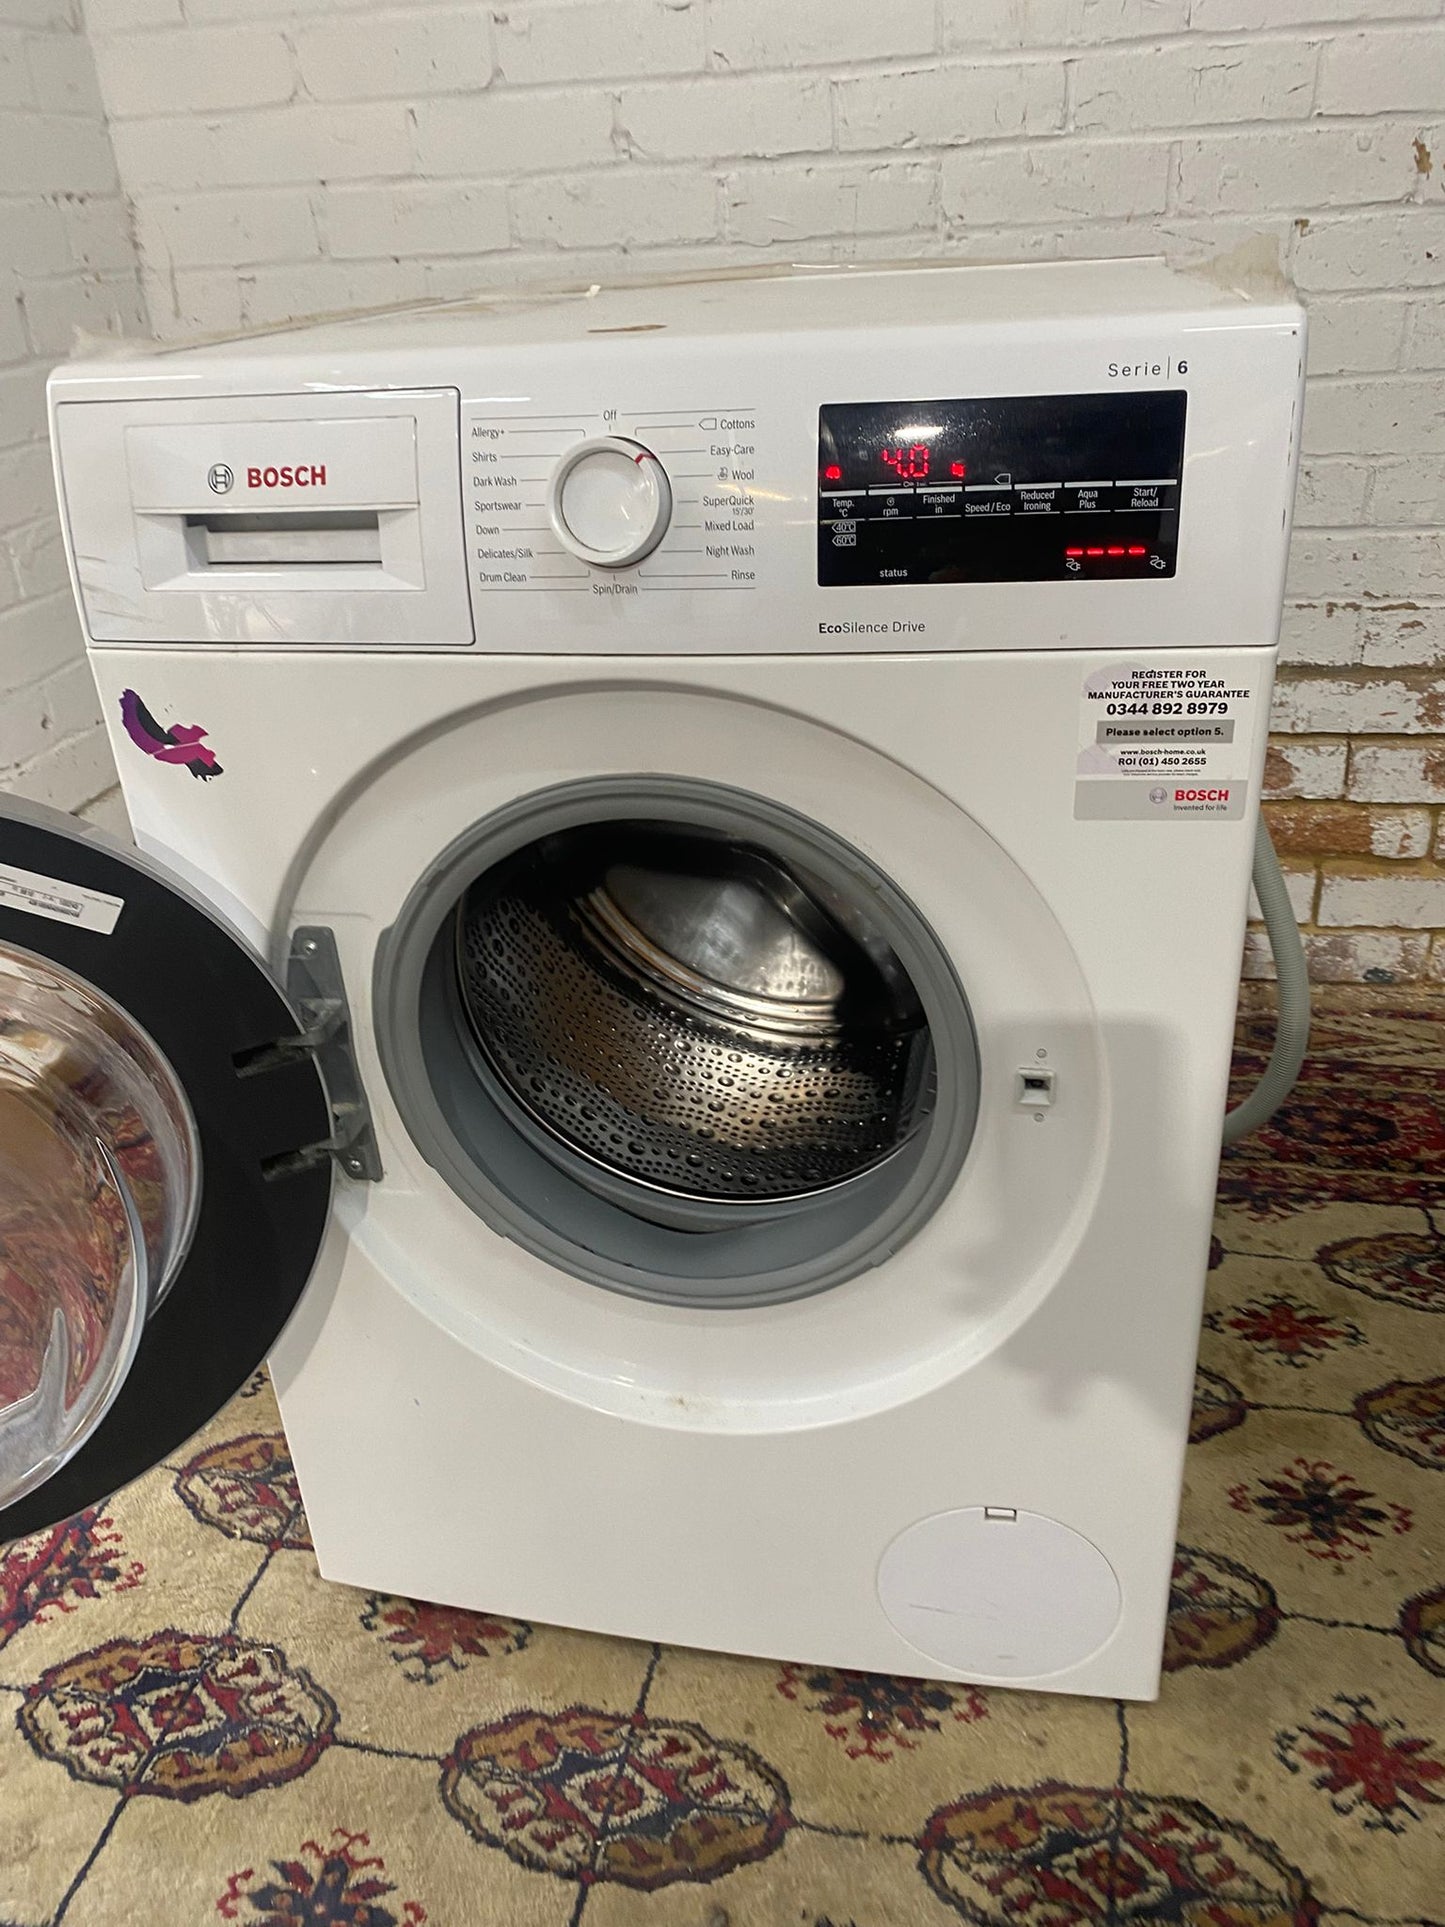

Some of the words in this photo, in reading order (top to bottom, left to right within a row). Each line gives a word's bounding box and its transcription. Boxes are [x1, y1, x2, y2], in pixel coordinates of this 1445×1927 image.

[1107, 361, 1161, 377] Serie
[1177, 360, 1188, 374] 6
[603, 410, 617, 421] Off
[720, 419, 755, 430] Cottons
[471, 427, 505, 439] Allergy+
[710, 444, 755, 457] Easy-Care
[472, 451, 497, 462] Shirts
[247, 465, 326, 488] BOSCH
[731, 469, 755, 480] Wool
[473, 476, 493, 487] Dark
[494, 475, 517, 486] Wash
[1020, 490, 1055, 500] Reduced
[1077, 489, 1099, 500] Aqua
[1133, 487, 1158, 498] Start/
[702, 495, 755, 508] SuperQuick
[832, 498, 855, 509] Temp.
[922, 494, 956, 505] Finished
[1079, 499, 1096, 509] Plus
[1130, 498, 1159, 508] Reload
[474, 501, 522, 513] Sportswear
[935, 504, 943, 514] in
[1023, 501, 1052, 512] Ironing
[882, 508, 899, 517] rpm
[476, 525, 500, 535] Down
[704, 520, 731, 532] Mixed
[732, 520, 755, 531] Load
[477, 547, 534, 559] Delicates/Silk
[705, 545, 729, 558] Night
[730, 545, 755, 556] Wash
[479, 572, 503, 583] Drum
[503, 571, 527, 582] Clean
[731, 569, 756, 580] Rinse
[879, 568, 908, 578] status
[592, 583, 639, 595] Spin/Drain
[818, 621, 889, 634] EcoSilence
[892, 621, 926, 633] Drive
[1131, 670, 1183, 679] REGISTER
[1185, 670, 1206, 679] FOR
[1112, 681, 1140, 689] YOUR
[1142, 681, 1168, 689] FREE
[1171, 680, 1195, 688] TWO
[1197, 680, 1225, 688] YEAR
[1087, 690, 1183, 699] MANUFACTURER'S
[1185, 690, 1250, 699] GUARANTEE
[1106, 703, 1149, 715] 0344
[1152, 702, 1183, 715] 892
[1187, 702, 1228, 715] 8979
[1106, 728, 1141, 737] Please
[1143, 727, 1175, 737] select
[1177, 727, 1212, 738] option
[1214, 727, 1224, 736] 5.
[1120, 748, 1206, 756] www.bosch-home.co.uk
[1118, 758, 1137, 766] ROI
[1138, 757, 1159, 767] (01)
[1161, 758, 1180, 766] 450
[1182, 757, 1207, 766] 2655
[1174, 789, 1230, 801] BOSCH
[1173, 803, 1204, 811] Invented
[1205, 803, 1215, 811] for
[1216, 803, 1228, 811] life
